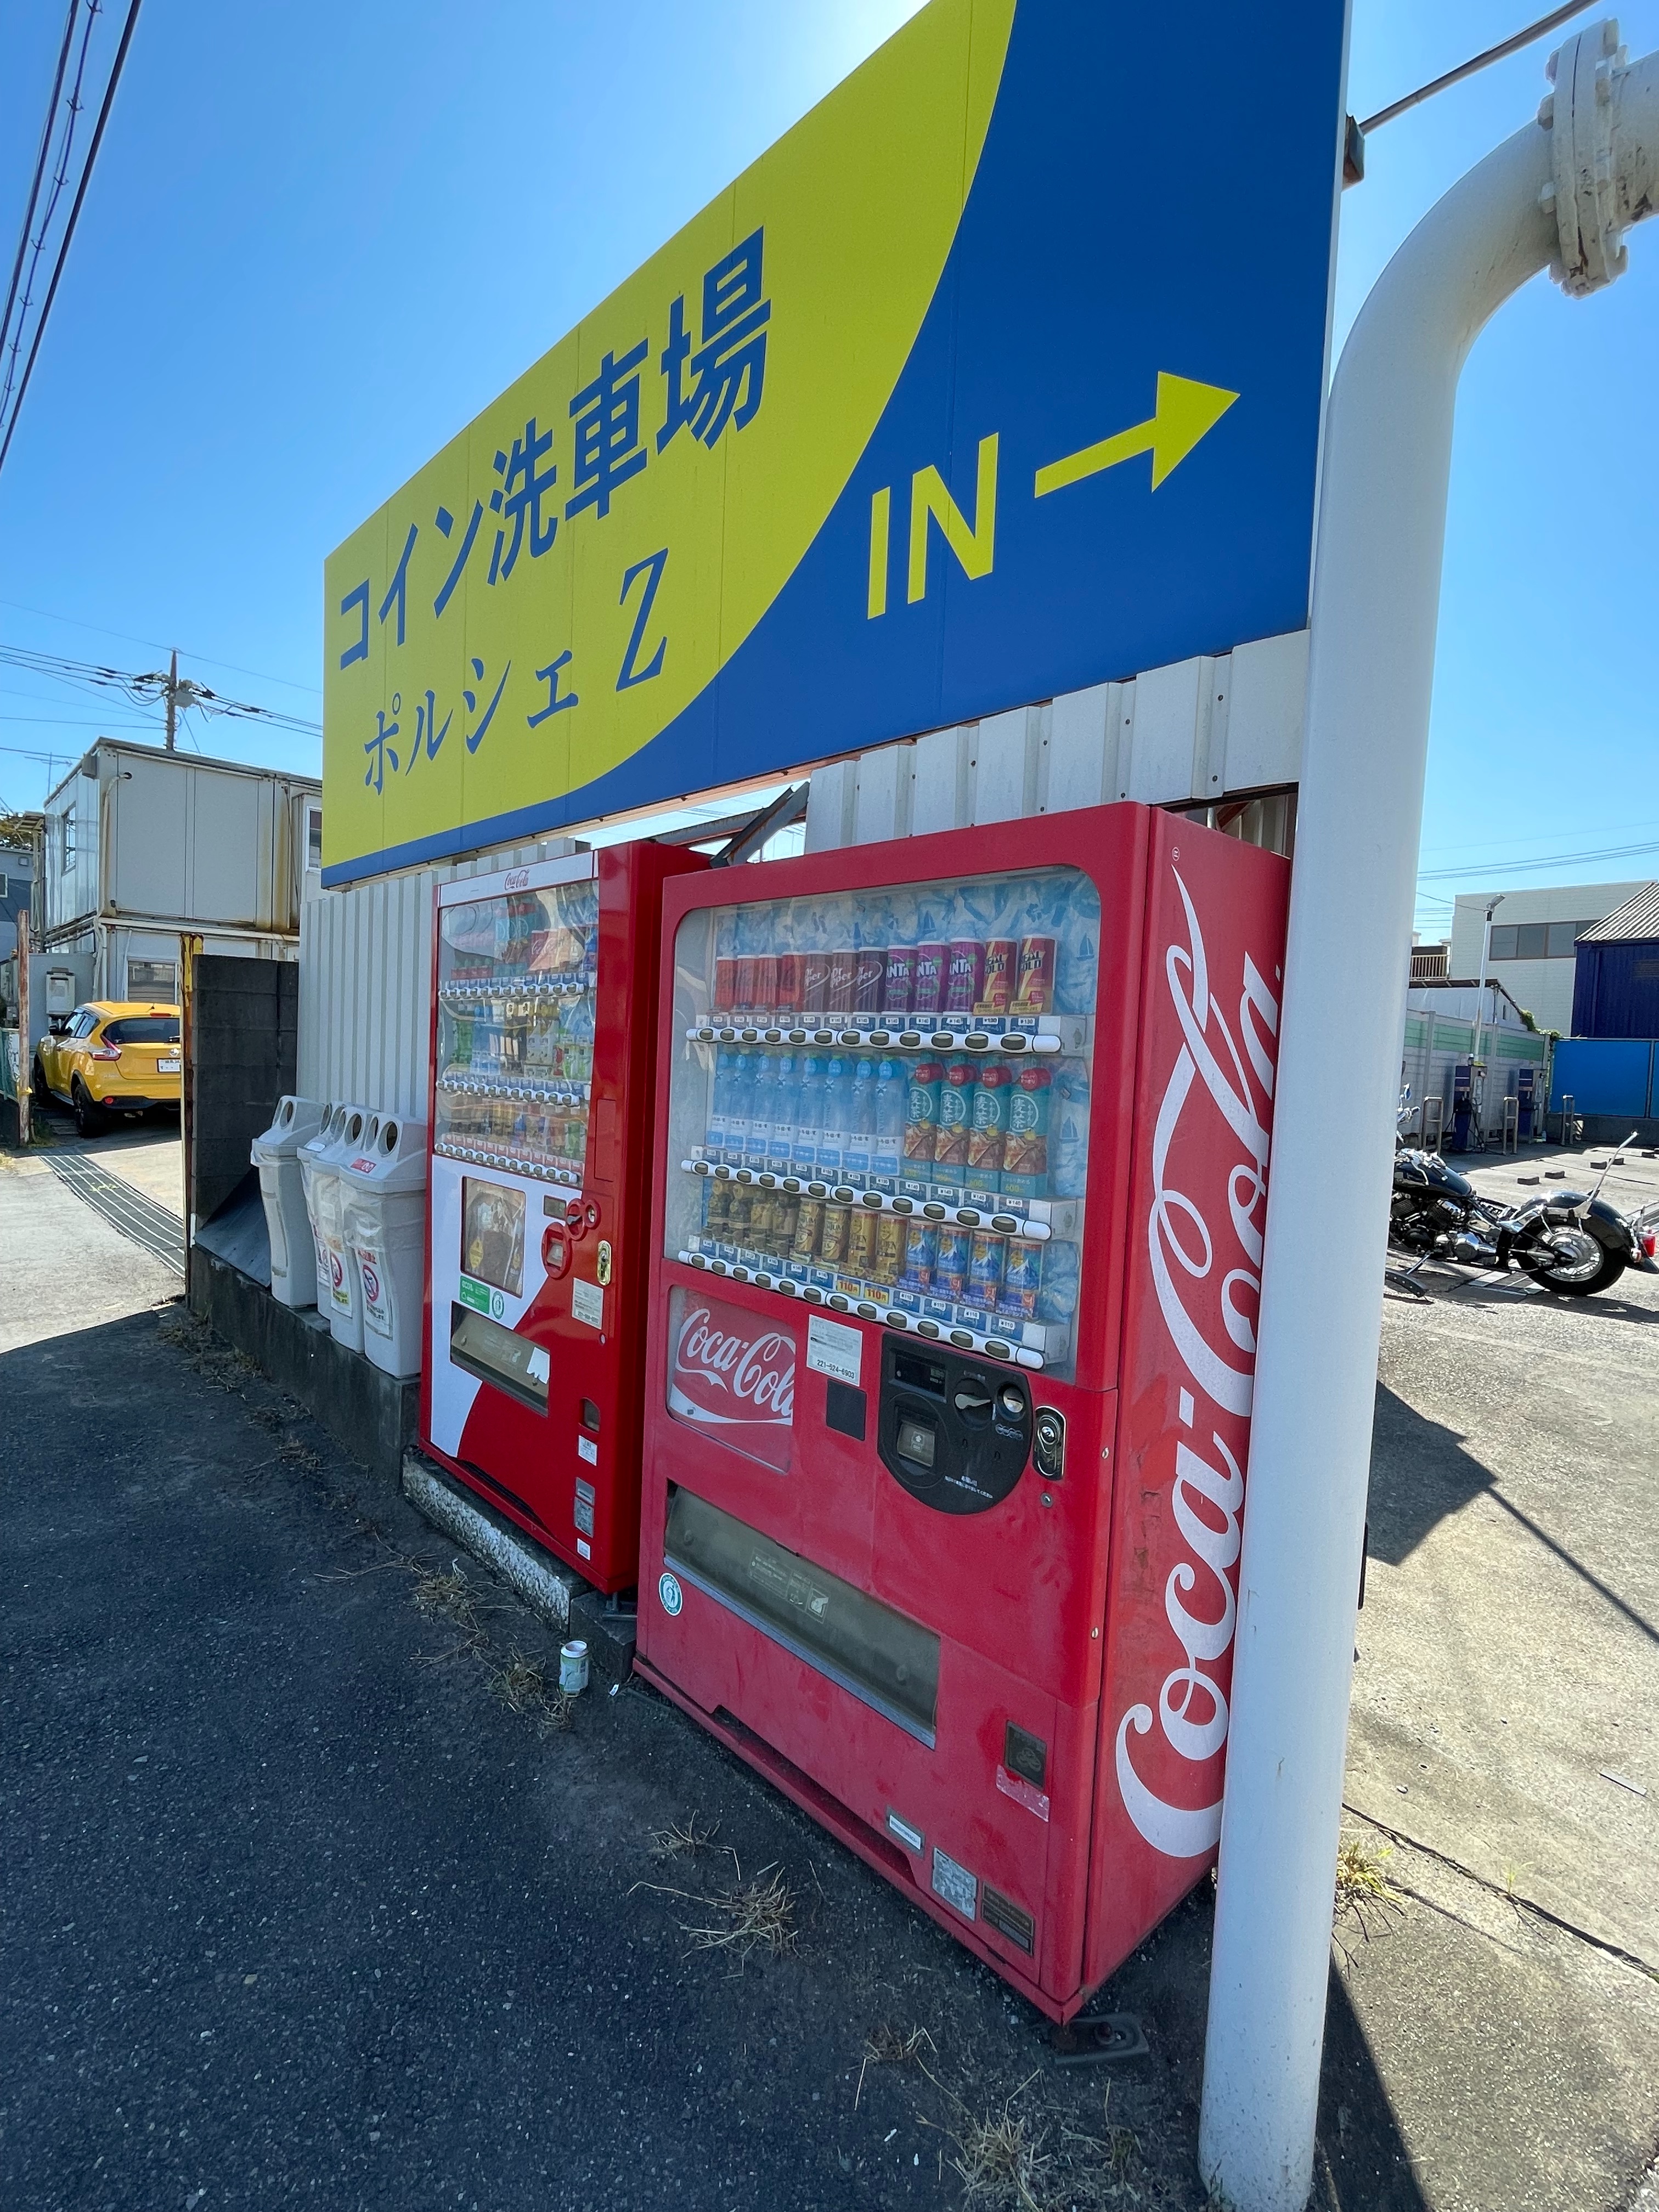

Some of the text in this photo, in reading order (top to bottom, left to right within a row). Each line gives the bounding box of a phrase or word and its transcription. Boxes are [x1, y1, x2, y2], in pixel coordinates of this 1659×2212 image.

[340, 225, 771, 670] コイン洗車場
[868, 432, 998, 620] IN
